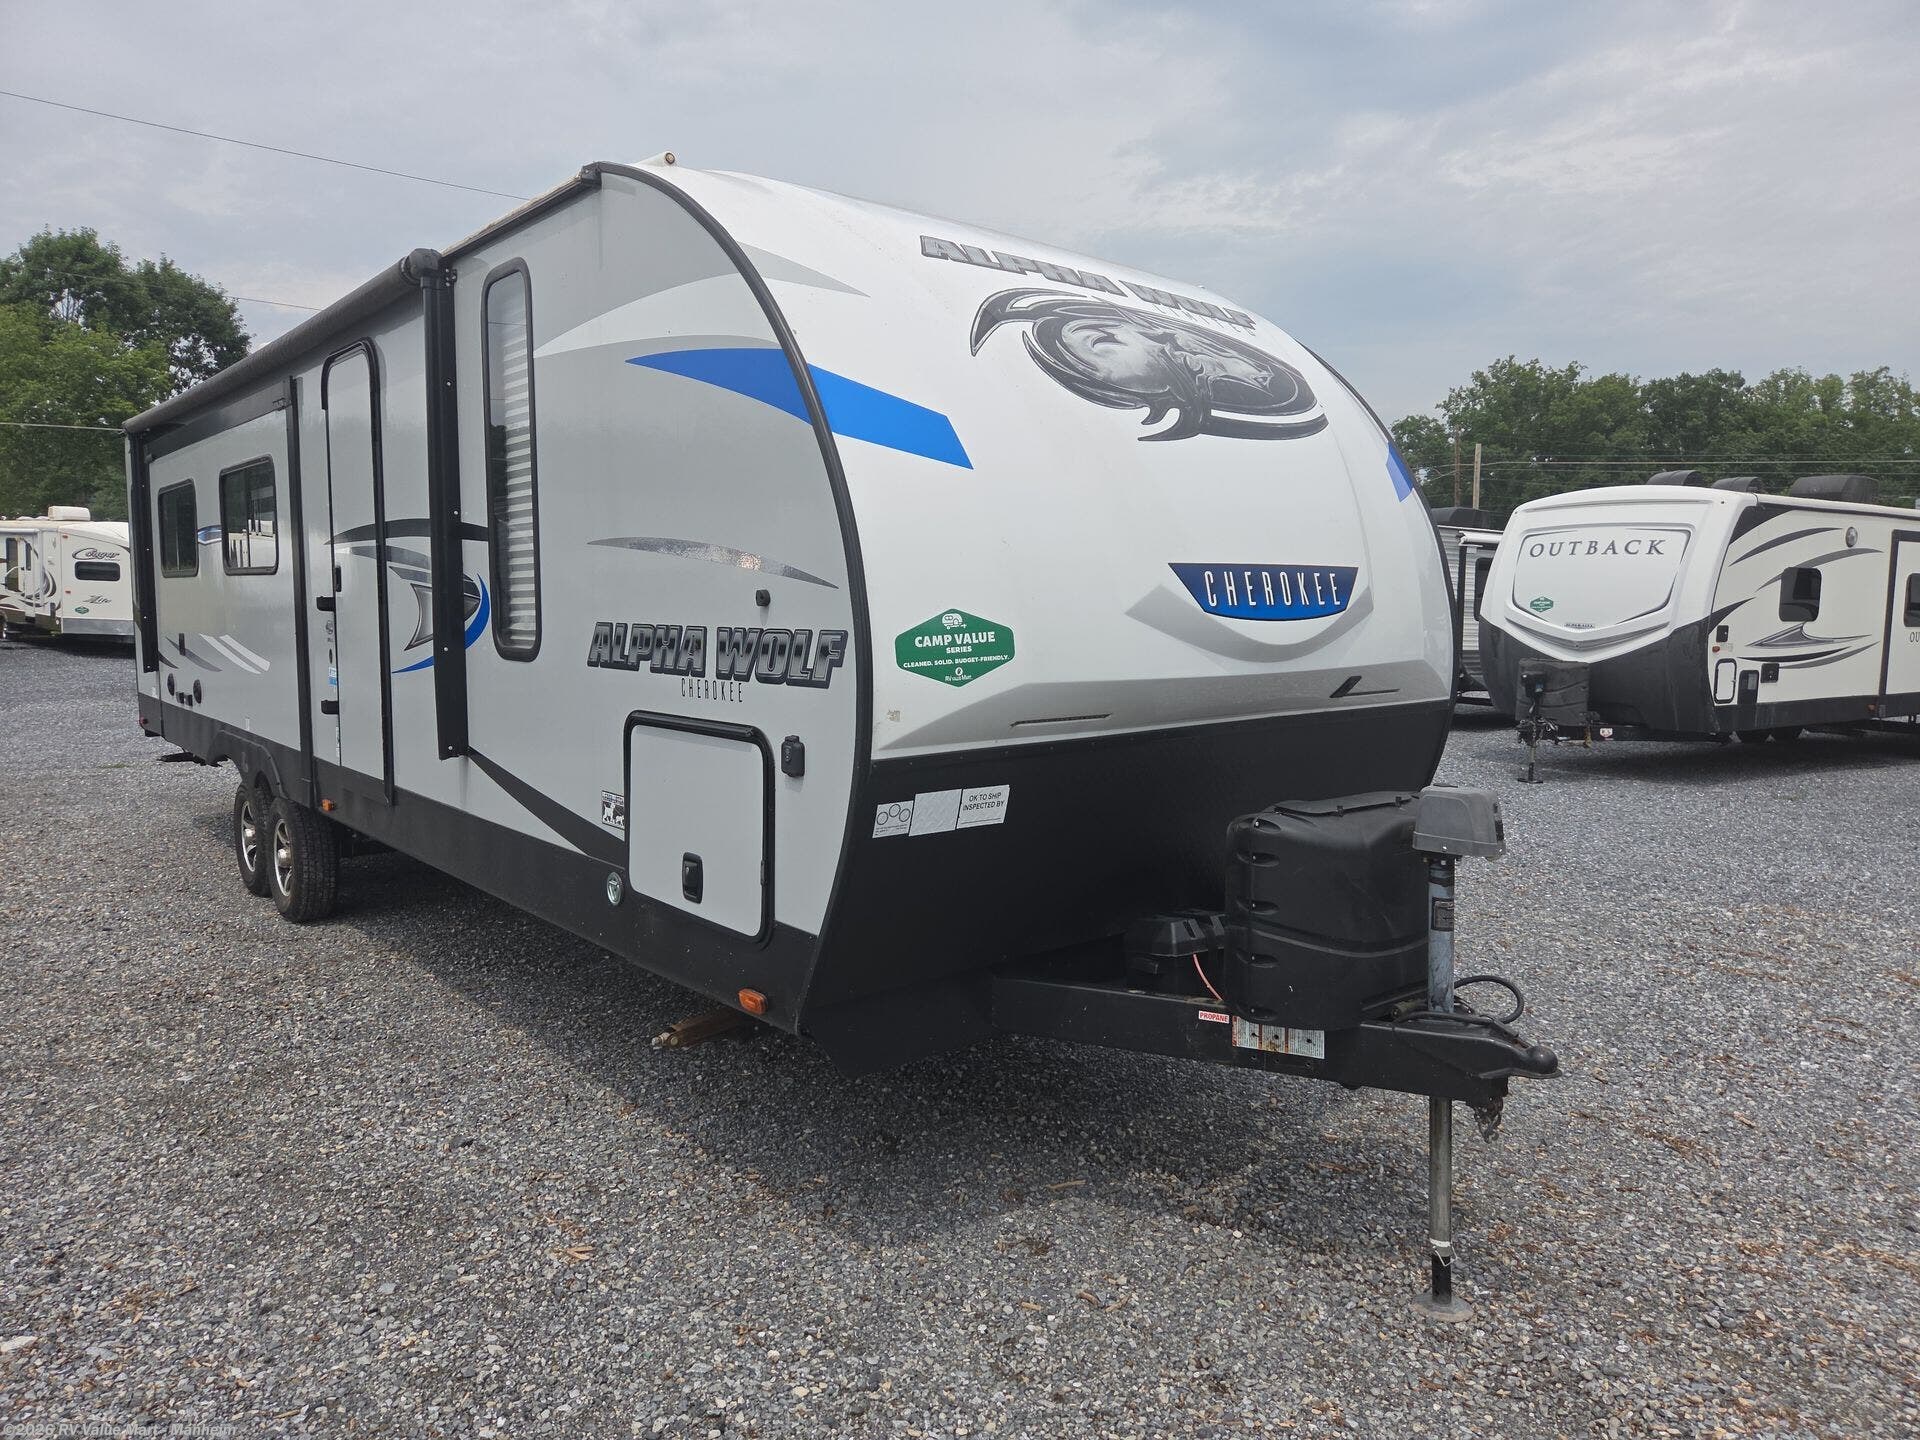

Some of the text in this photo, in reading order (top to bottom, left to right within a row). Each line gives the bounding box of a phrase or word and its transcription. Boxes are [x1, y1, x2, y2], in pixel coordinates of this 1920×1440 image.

[920, 235, 1129, 297] ALPHA
[1529, 539, 1666, 558] OUTBACK
[1204, 570, 1341, 607] CHEROKEE
[914, 631, 996, 648] CAMP VALUE
[587, 621, 849, 689] ALPHA WOLF
[945, 645, 973, 654] SERIES
[681, 677, 743, 703] CHEROKEE
[968, 794, 979, 802] OK
[988, 792, 1002, 800] SHIP
[962, 801, 996, 812] INSPECTED
[1199, 1011, 1229, 1023] PROPANE
